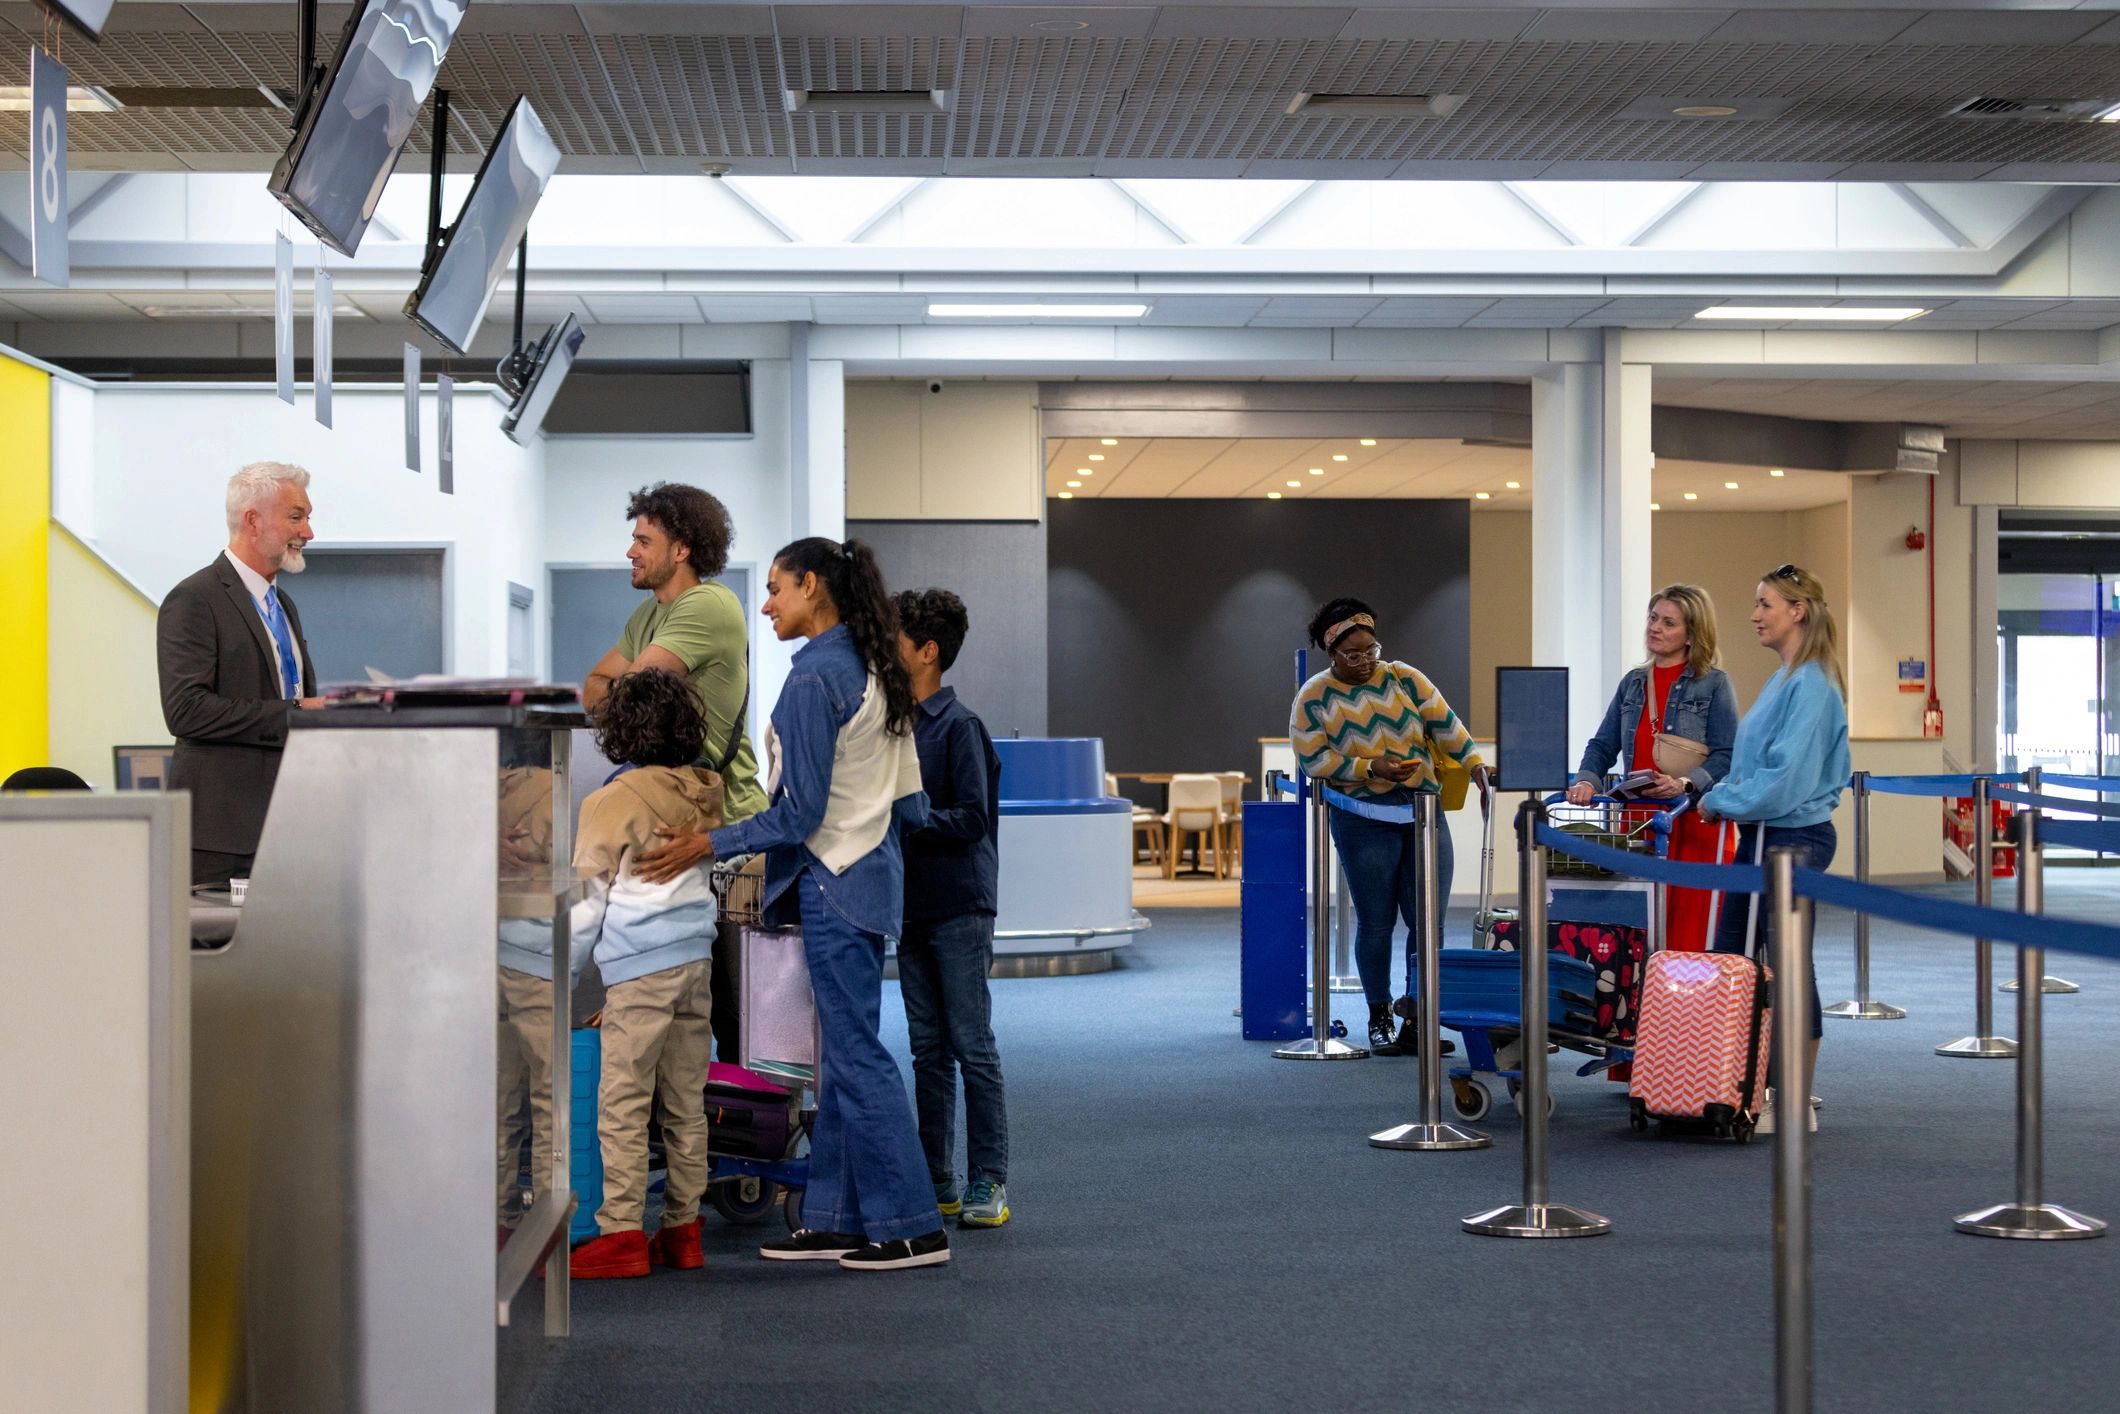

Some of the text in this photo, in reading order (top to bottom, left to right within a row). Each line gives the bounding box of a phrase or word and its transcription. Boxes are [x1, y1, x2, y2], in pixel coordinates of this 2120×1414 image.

[41, 106, 59, 223] 8
[280, 271, 289, 354] 9
[316, 302, 330, 384] 10
